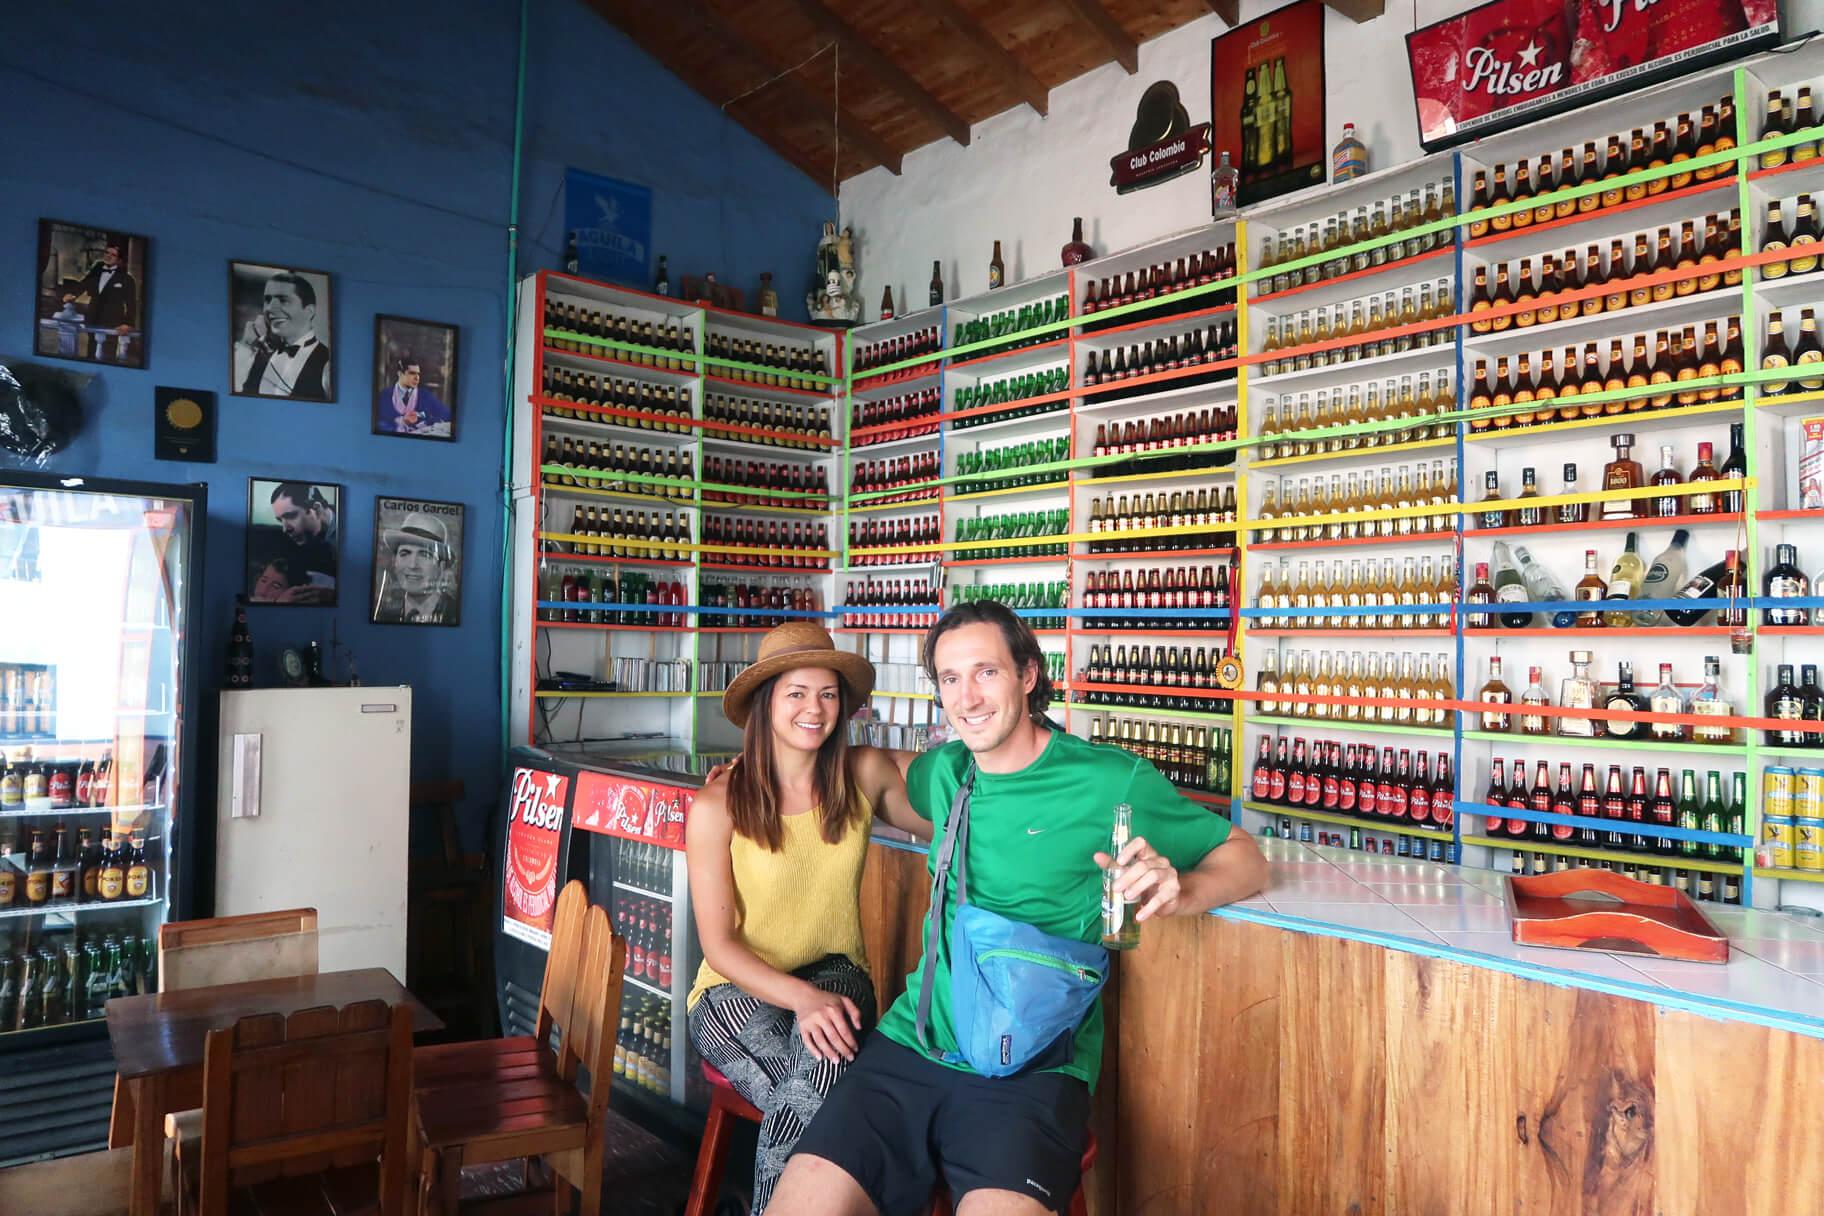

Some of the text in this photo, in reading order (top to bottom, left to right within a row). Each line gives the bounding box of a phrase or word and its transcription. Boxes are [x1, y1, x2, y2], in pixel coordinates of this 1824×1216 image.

[1463, 46, 1562, 95] Pilsen
[1556, 85, 1582, 98] MENORES
[1582, 82, 1590, 90] DE
[1615, 67, 1637, 79] EXCESO
[1637, 64, 1646, 72] DE
[1646, 56, 1673, 69] ALCOHOL
[1673, 53, 1682, 61] ES
[1681, 40, 1721, 58] PERJUDICIAL
[1721, 34, 1739, 45] PARA
[1739, 31, 1748, 39] LA
[1130, 153, 1148, 170] Club
[1149, 140, 1186, 162] Colombia
[383, 500, 460, 516] Carlos Gardel
[510, 768, 564, 832] Pilsen
[616, 800, 642, 836] Pilsen
[655, 800, 685, 827] Pilsen
